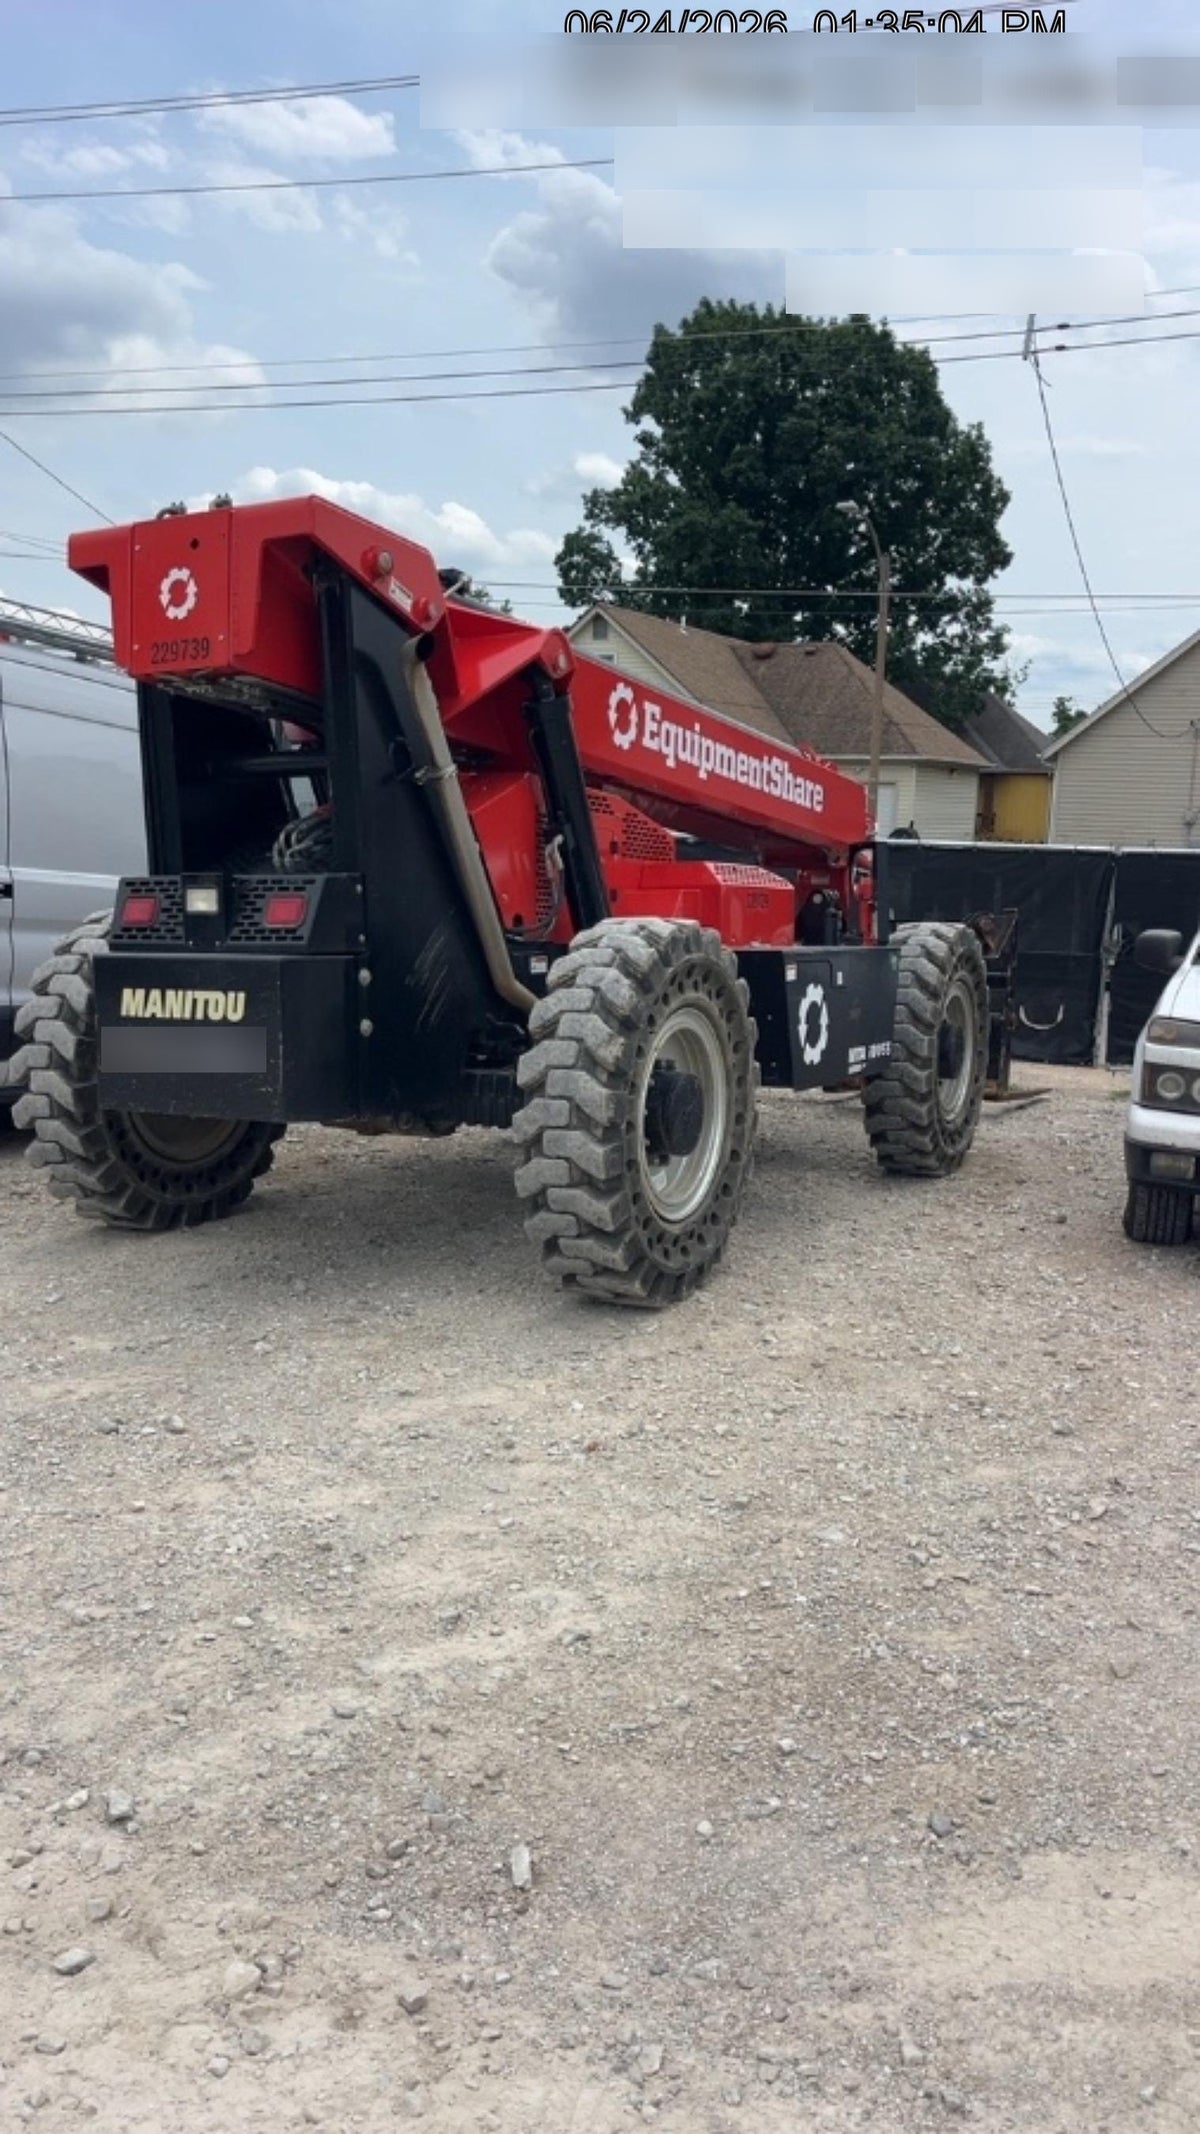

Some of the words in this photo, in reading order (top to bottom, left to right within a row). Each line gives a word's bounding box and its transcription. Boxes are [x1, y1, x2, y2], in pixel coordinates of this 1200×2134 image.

[151, 637, 210, 665] 229739
[641, 700, 824, 813] EquipmentShare
[120, 987, 246, 1023] MANITOU
